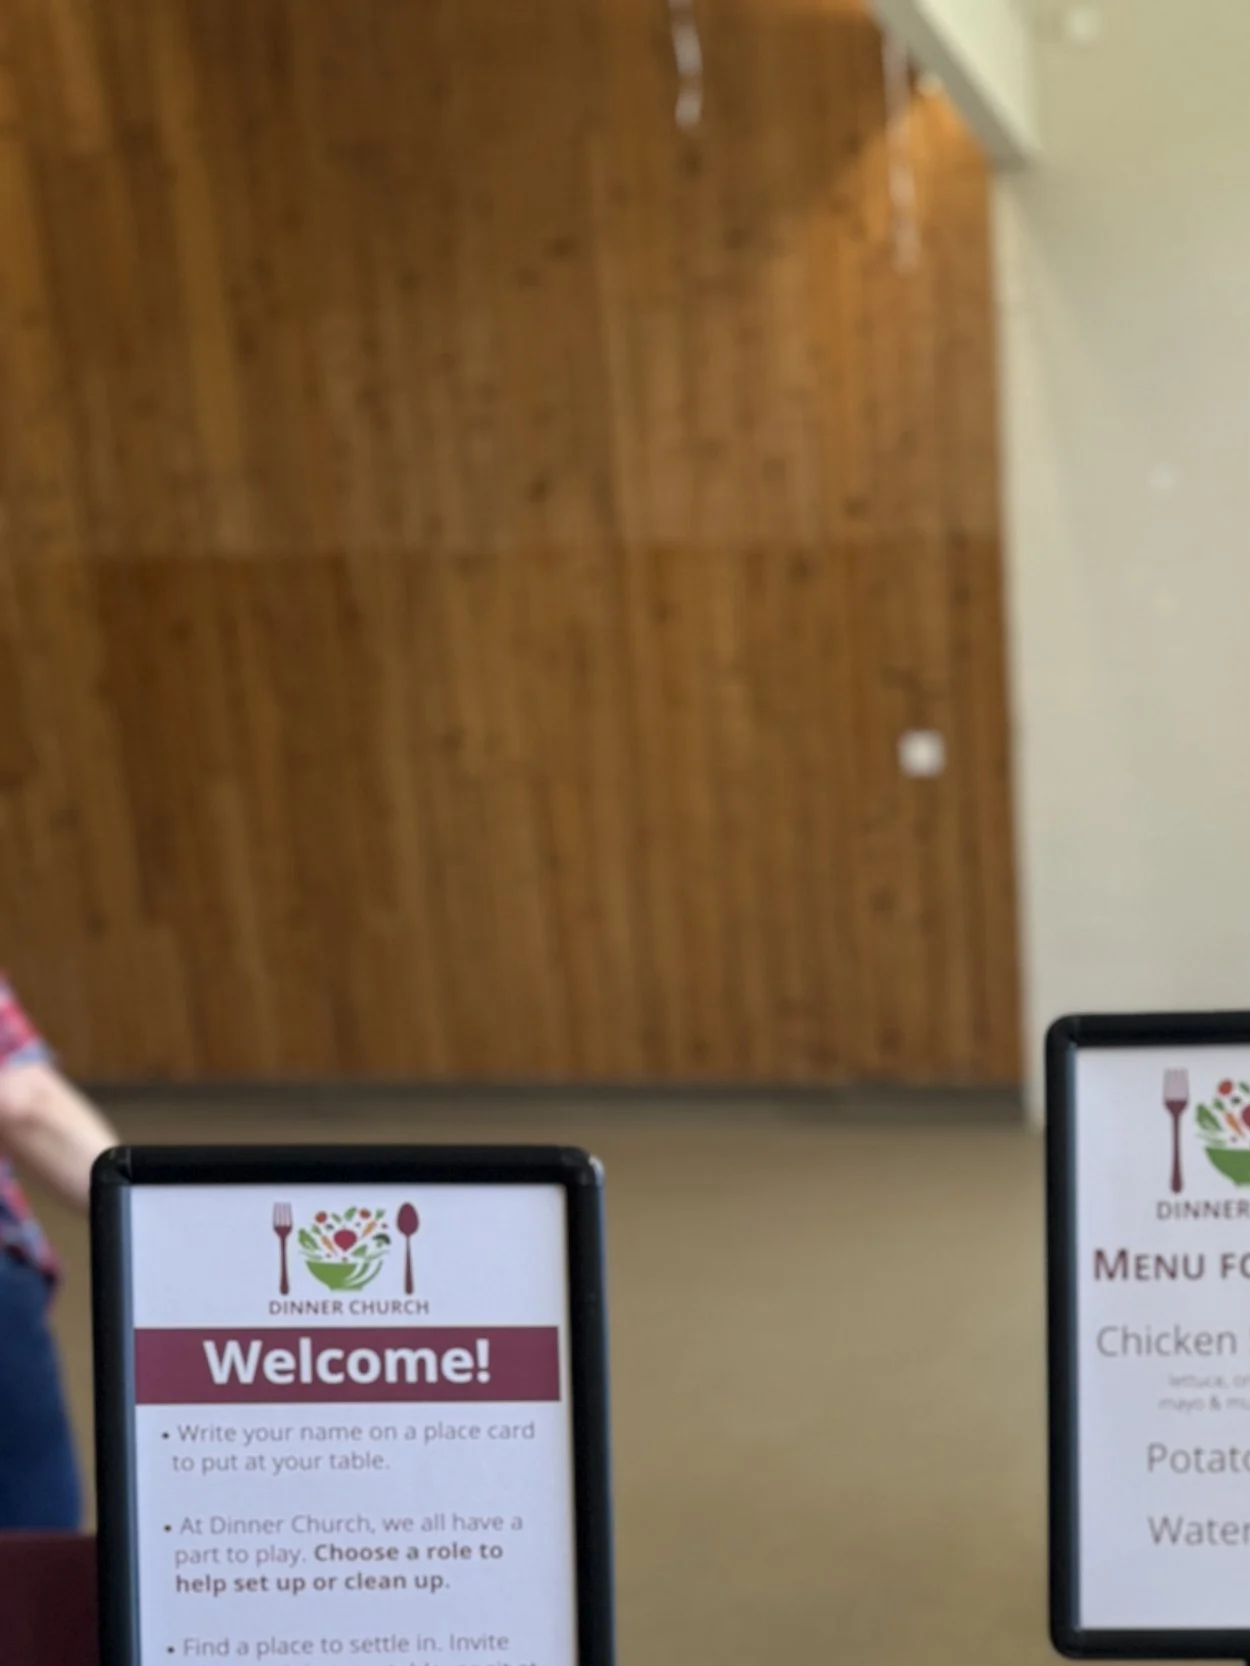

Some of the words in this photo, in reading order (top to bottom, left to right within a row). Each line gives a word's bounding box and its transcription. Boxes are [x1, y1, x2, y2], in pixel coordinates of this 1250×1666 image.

[1156, 1199, 1250, 1220] DINNER
[268, 1299, 343, 1315] DINNER
[348, 1299, 429, 1315] CHURCH
[1096, 1324, 1237, 1358] Chicken
[203, 1337, 490, 1384] Welcome!
[176, 1423, 237, 1443] Write
[242, 1426, 293, 1448] your
[299, 1425, 363, 1442] name
[369, 1425, 397, 1441] on
[404, 1425, 417, 1441] a
[423, 1421, 481, 1446] place
[487, 1421, 535, 1440] card
[175, 1547, 219, 1568] part
[226, 1547, 249, 1563] to
[256, 1545, 305, 1568] play.
[313, 1543, 399, 1562] Choose
[405, 1546, 419, 1561] a
[426, 1541, 472, 1560] role
[479, 1543, 503, 1560] to
[175, 1573, 227, 1598] help
[233, 1575, 269, 1592] set
[276, 1577, 306, 1596] up
[312, 1576, 337, 1591] or
[344, 1571, 407, 1590] clean
[414, 1574, 449, 1594] up.
